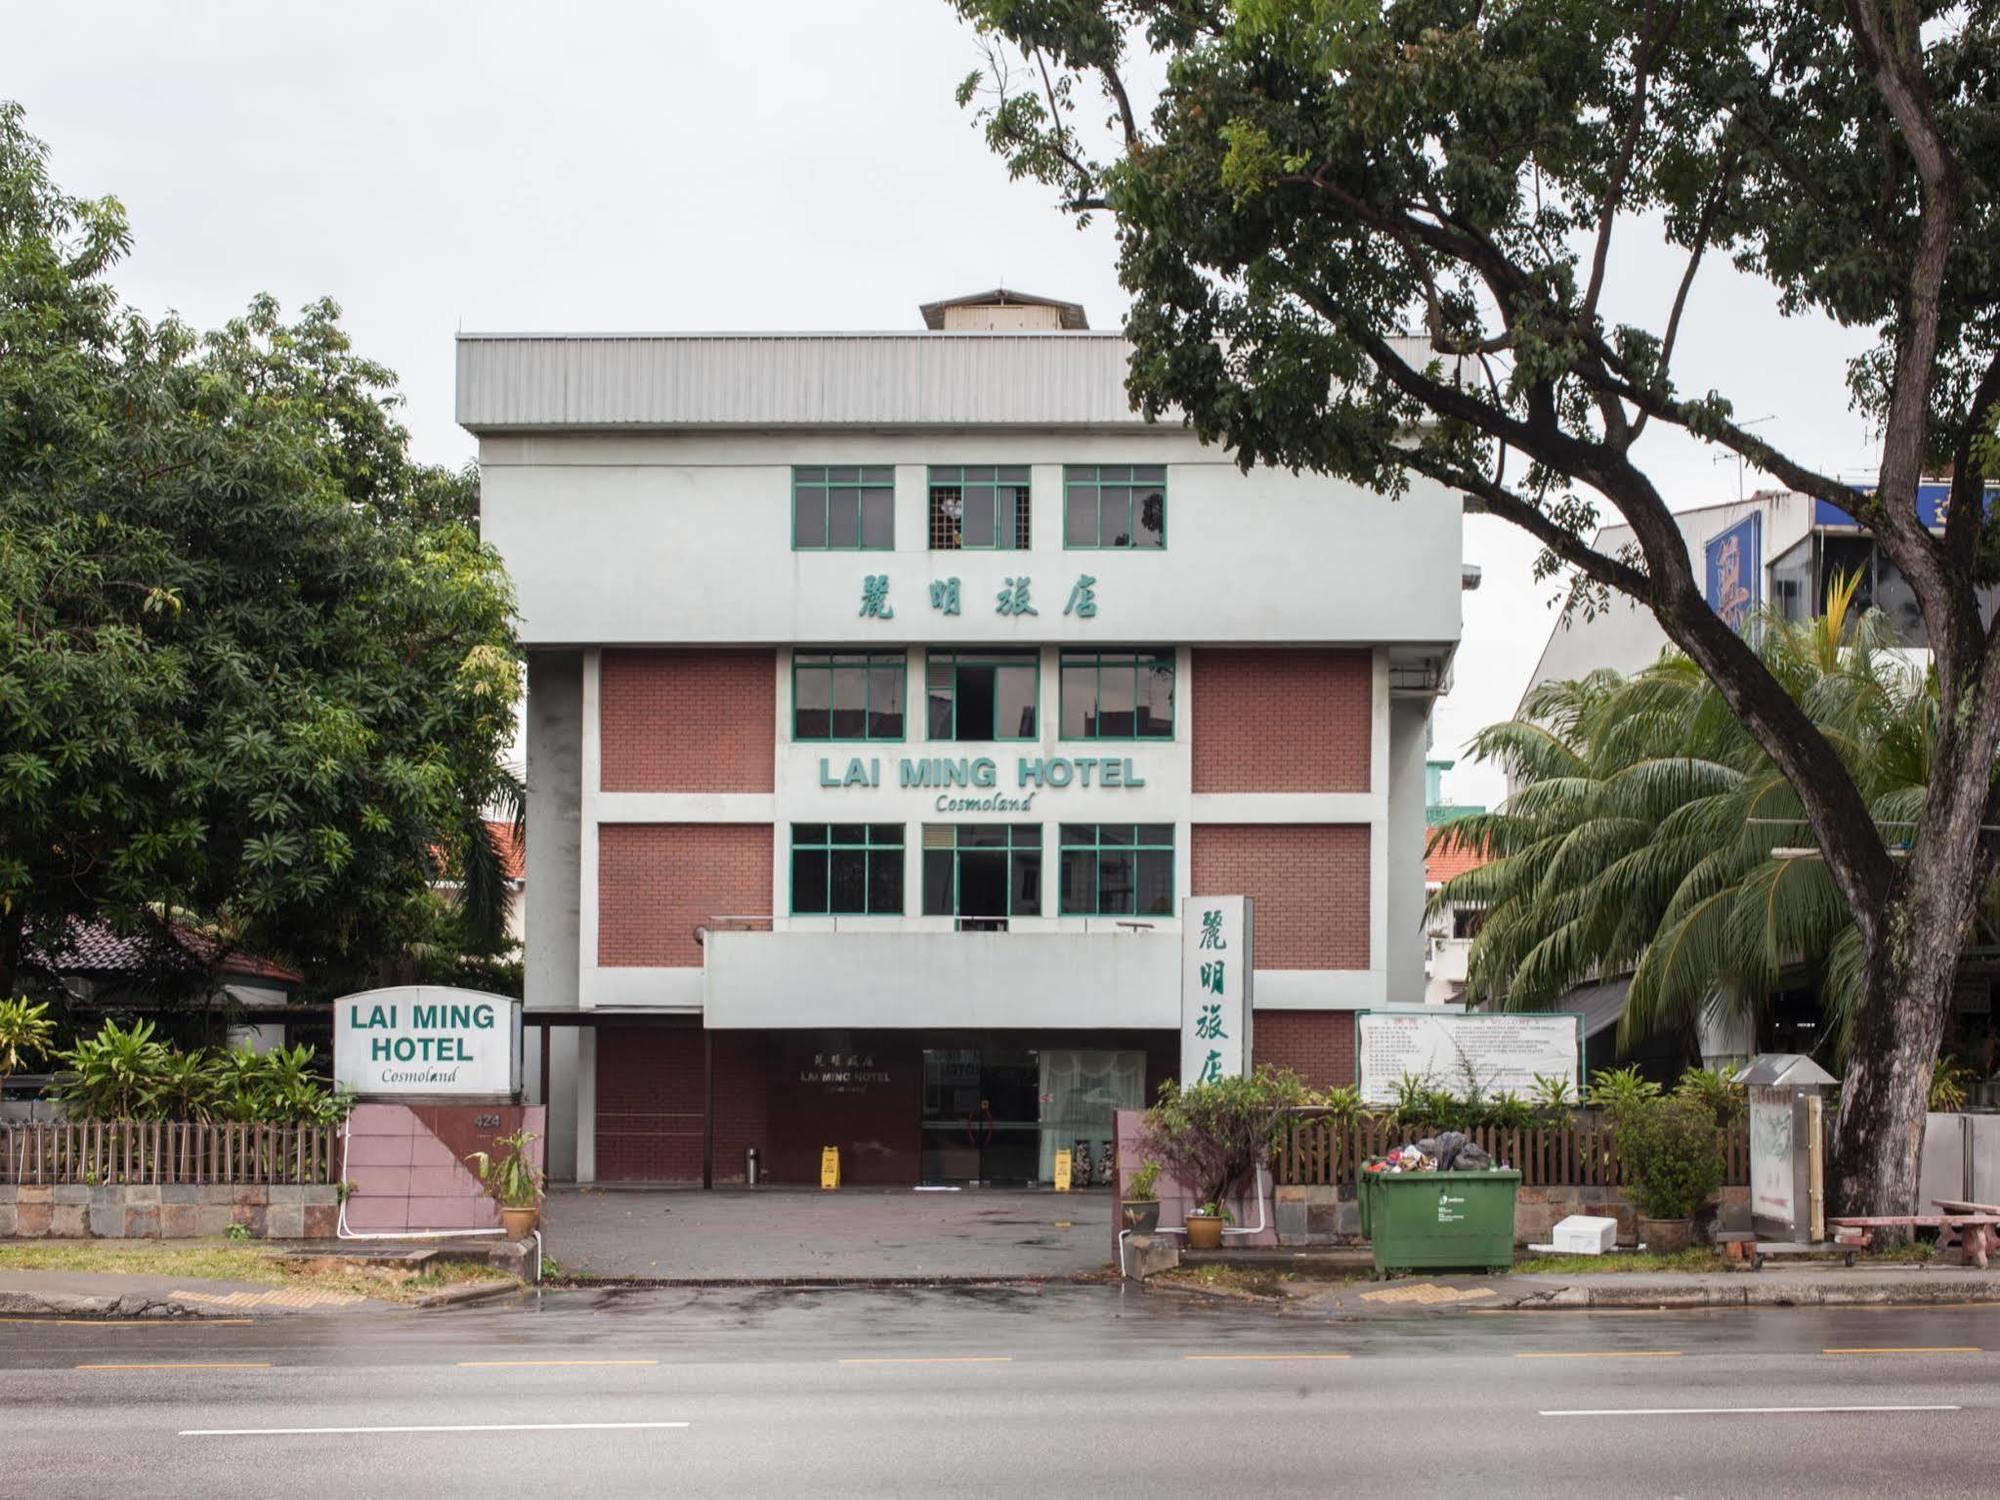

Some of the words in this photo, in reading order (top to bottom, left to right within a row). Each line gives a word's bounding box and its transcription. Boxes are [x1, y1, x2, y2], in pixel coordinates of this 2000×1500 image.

[820, 758, 880, 787] LAI
[899, 757, 996, 788] MING
[1018, 757, 1146, 788] HOTEL
[935, 792, 1034, 812] Cosmoland
[351, 1005, 397, 1029] LAI
[413, 1004, 495, 1029] MING
[371, 1038, 474, 1062] HOTEL
[381, 1066, 460, 1083] Cosmoland
